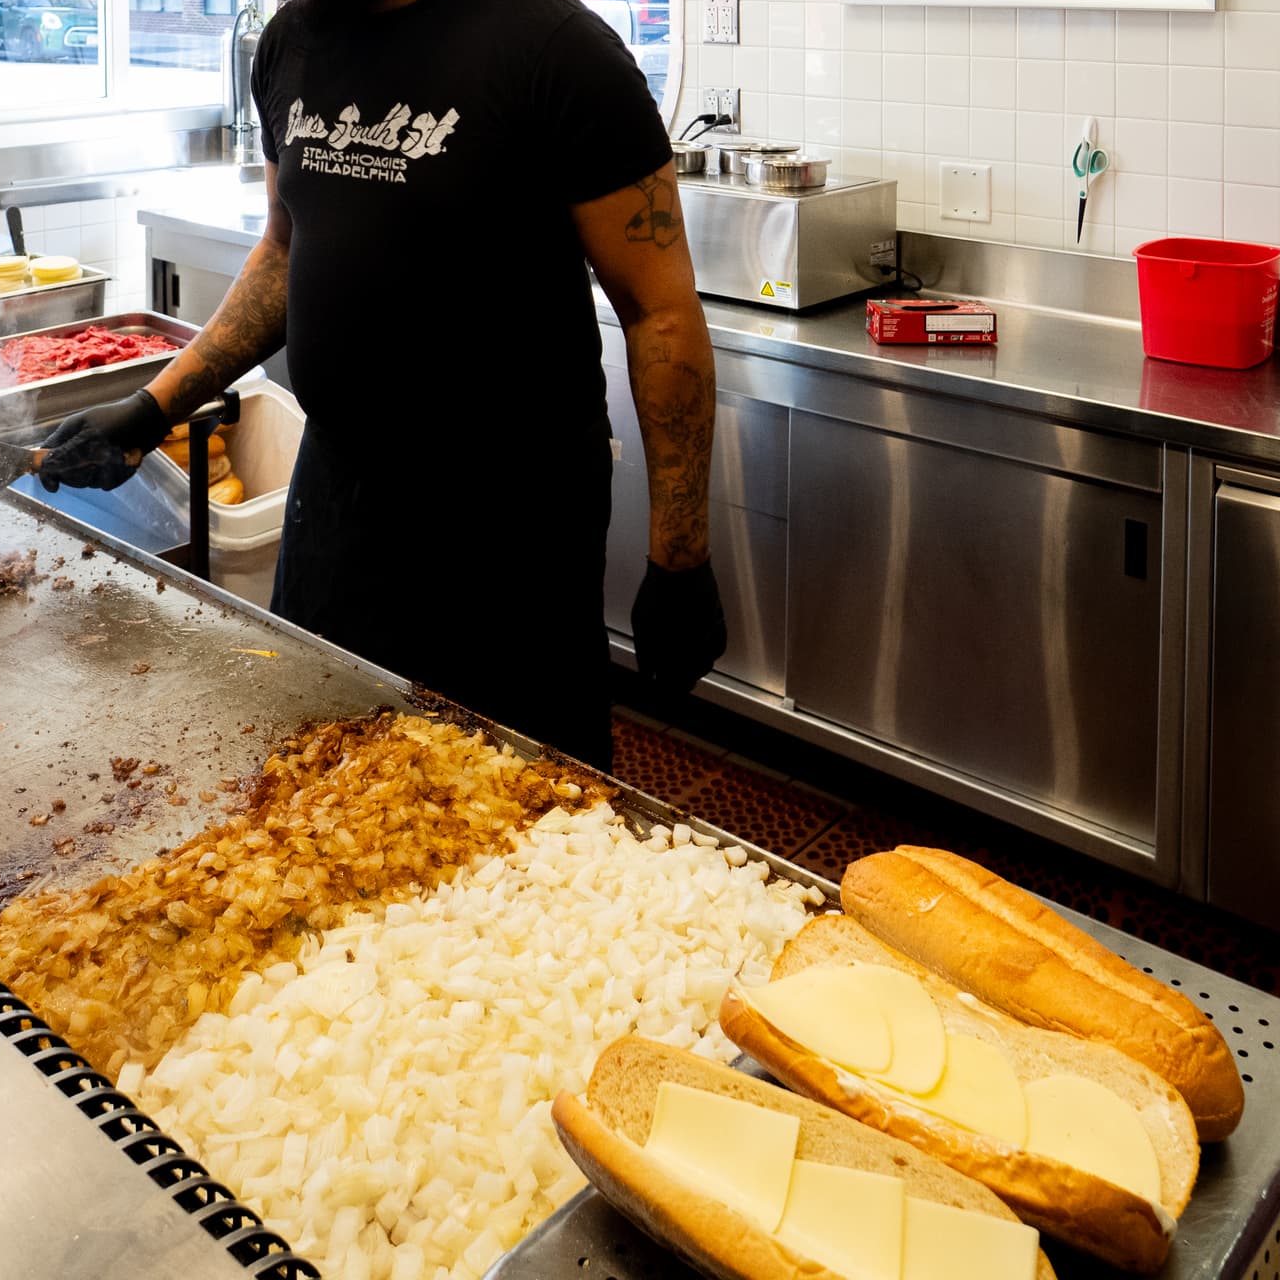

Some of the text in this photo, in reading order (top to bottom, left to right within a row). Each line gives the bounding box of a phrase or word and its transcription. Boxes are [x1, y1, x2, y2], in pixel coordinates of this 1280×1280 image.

[303, 146, 408, 171] STEAKS HOAGIES
[301, 159, 407, 184] PHILADELPHIA
